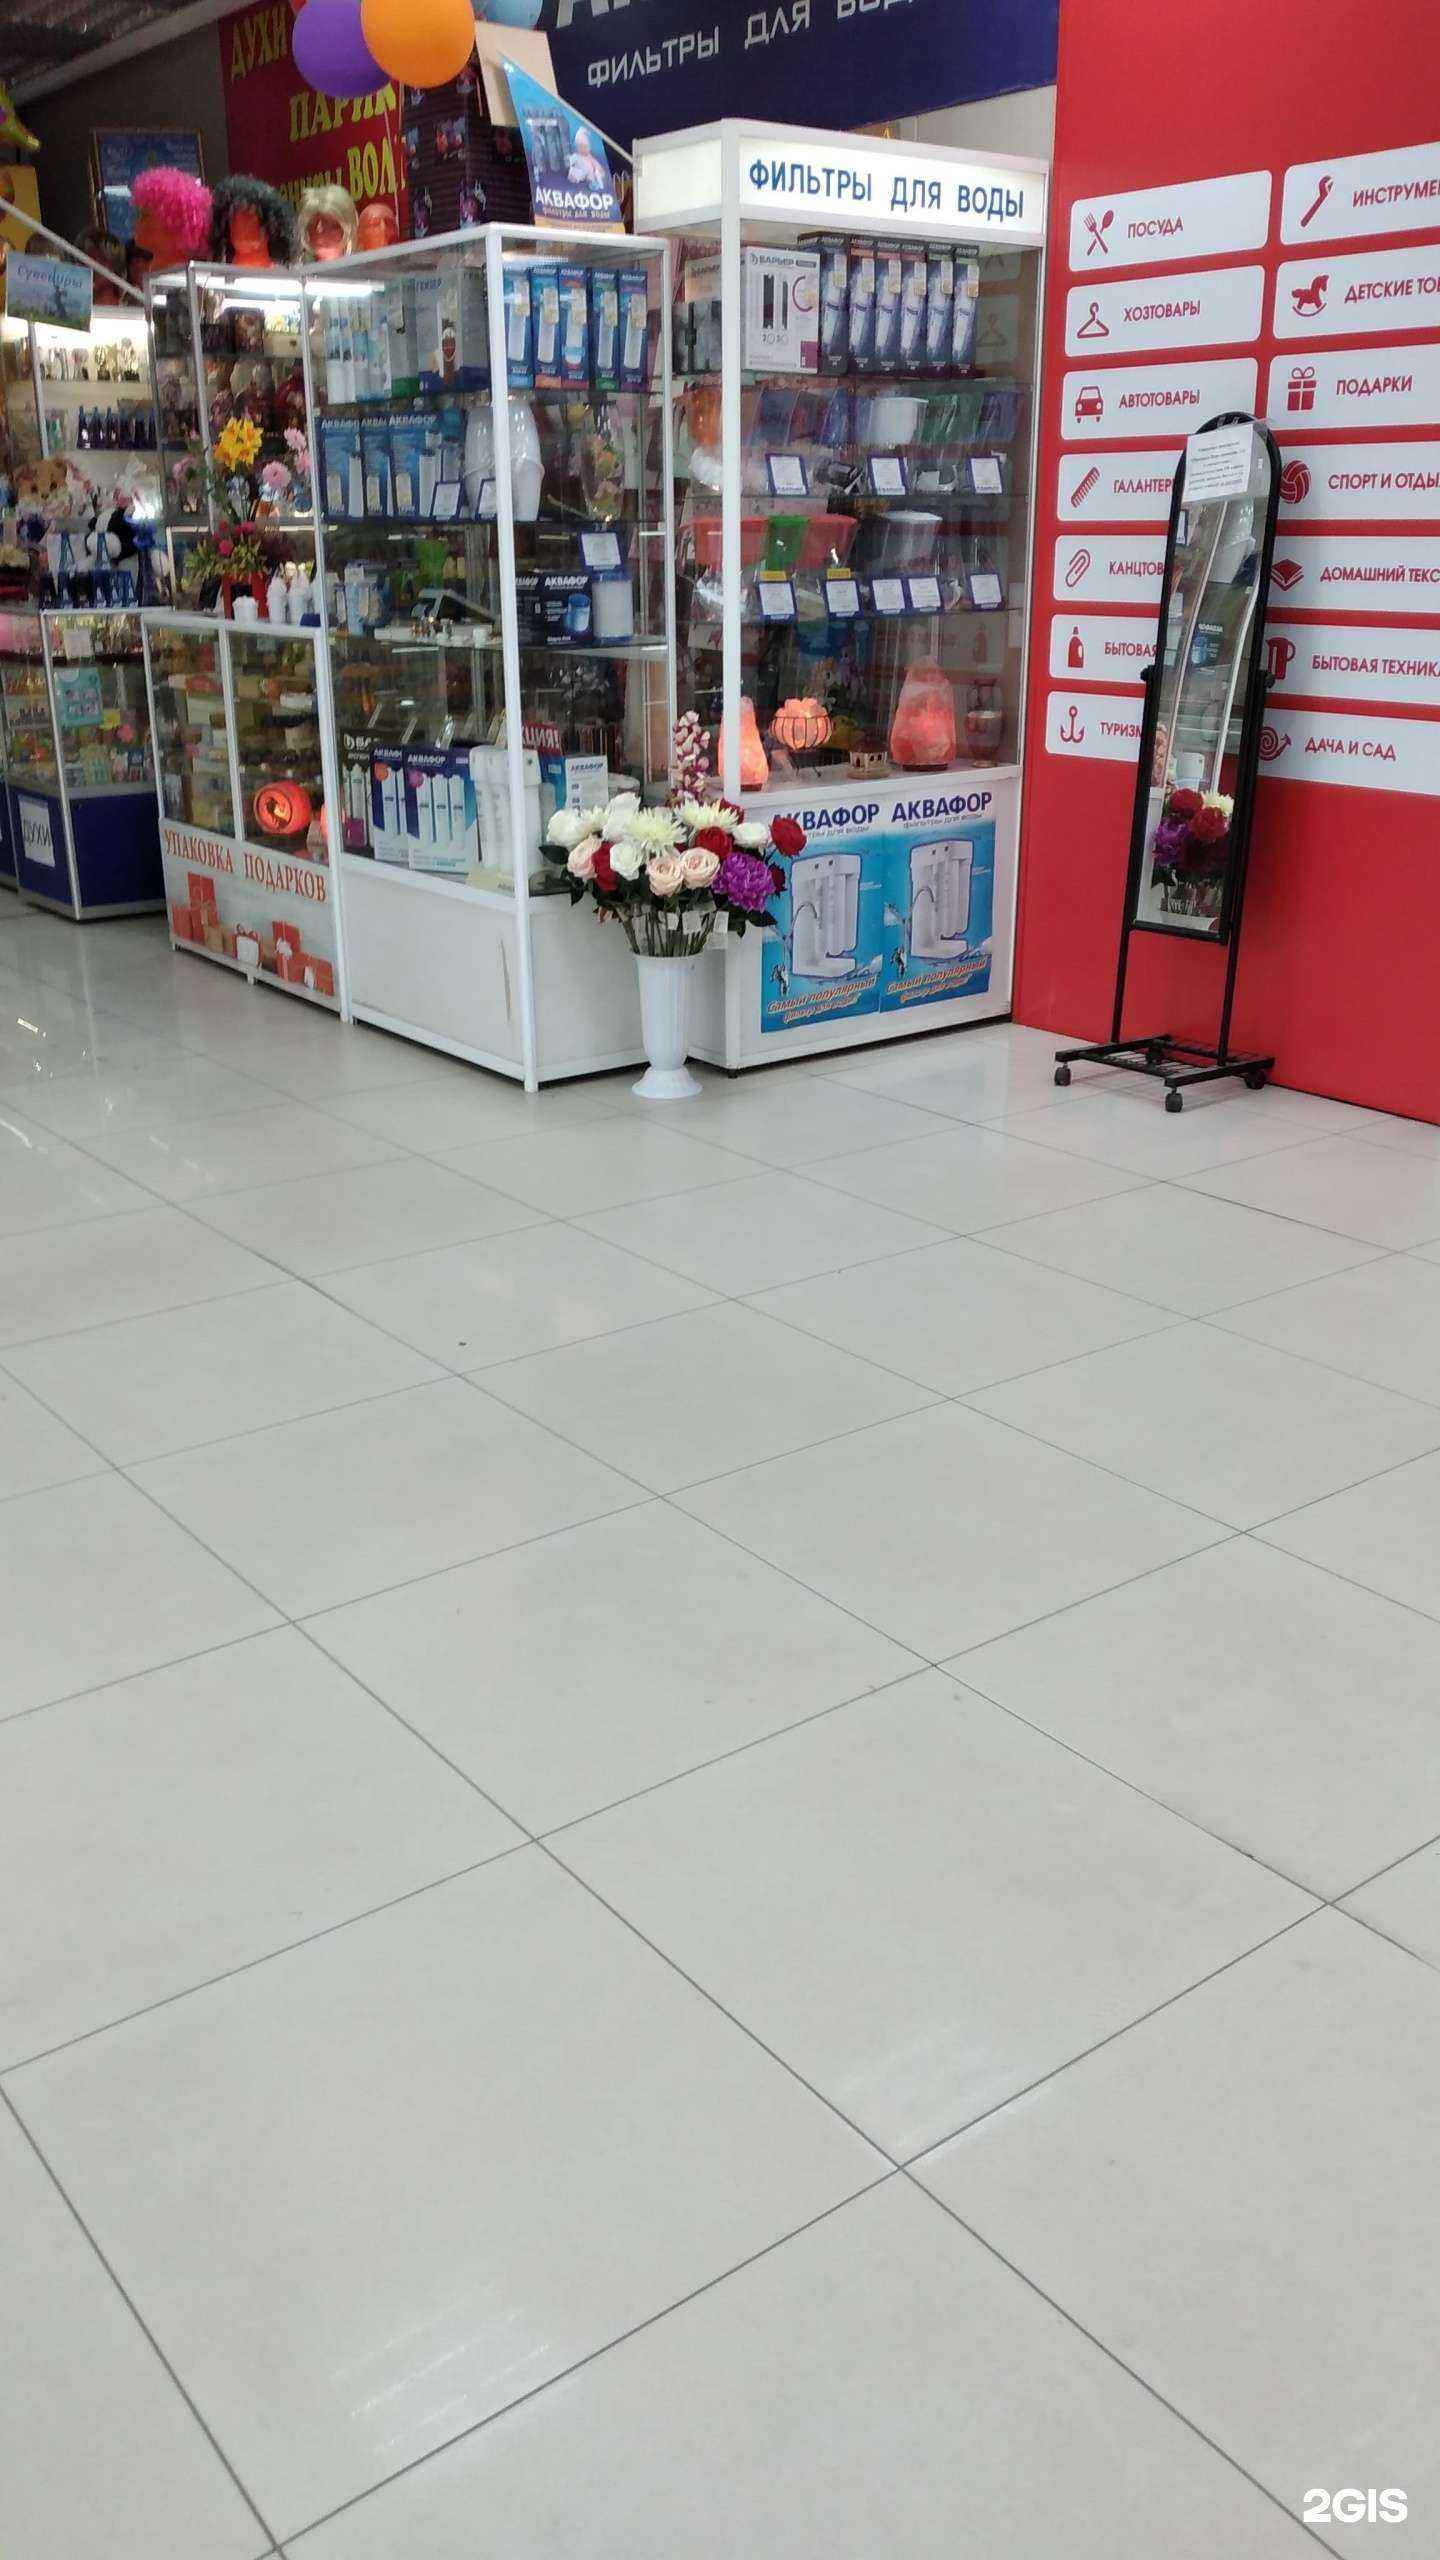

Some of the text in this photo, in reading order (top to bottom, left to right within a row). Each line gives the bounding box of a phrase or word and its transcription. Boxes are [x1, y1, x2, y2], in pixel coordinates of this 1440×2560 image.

[230, 4, 288, 82] ДУХИ
[587, 0, 811, 88] ФИЛЬТРЫ ДЛЯ
[347, 137, 405, 202] ВОЛ
[535, 186, 614, 211] АКВАФОР
[750, 159, 1024, 222] ФИЛЬТРЫ ДЛЯ ВОДЫ
[1352, 178, 1440, 208] ИНСТРУМЕ
[1127, 216, 1184, 239] ПОСУДА
[1344, 279, 1413, 304] ДЕТСКИЕ
[1123, 300, 1201, 323] ХОЗТОВАРЫ
[1336, 374, 1413, 397] ПОДАРКИ
[1118, 389, 1200, 409] АВТОТОВАРЫ
[1113, 478, 1174, 494] ГАЛАНТЕР
[1328, 472, 1440, 491] СПОРТ И ОТДЫ
[544, 575, 589, 587] АКВАФОР
[1108, 561, 1165, 578] КАНЦТОВ
[1320, 565, 1405, 583] ДОМАШНИЙ
[1104, 641, 1157, 657] БЫТОВАЯ
[1312, 654, 1440, 678] БЫТОВАЯ ТЕХНИК
[407, 754, 447, 765] АКВАФОР
[1305, 737, 1396, 761] ДАЧА И САД
[772, 804, 880, 831] ВАФОР
[891, 792, 992, 822] АКВАФОР
[23, 818, 51, 848] ДУХИ
[163, 829, 327, 902] УПАКОВКА ПОДАРКОВ
